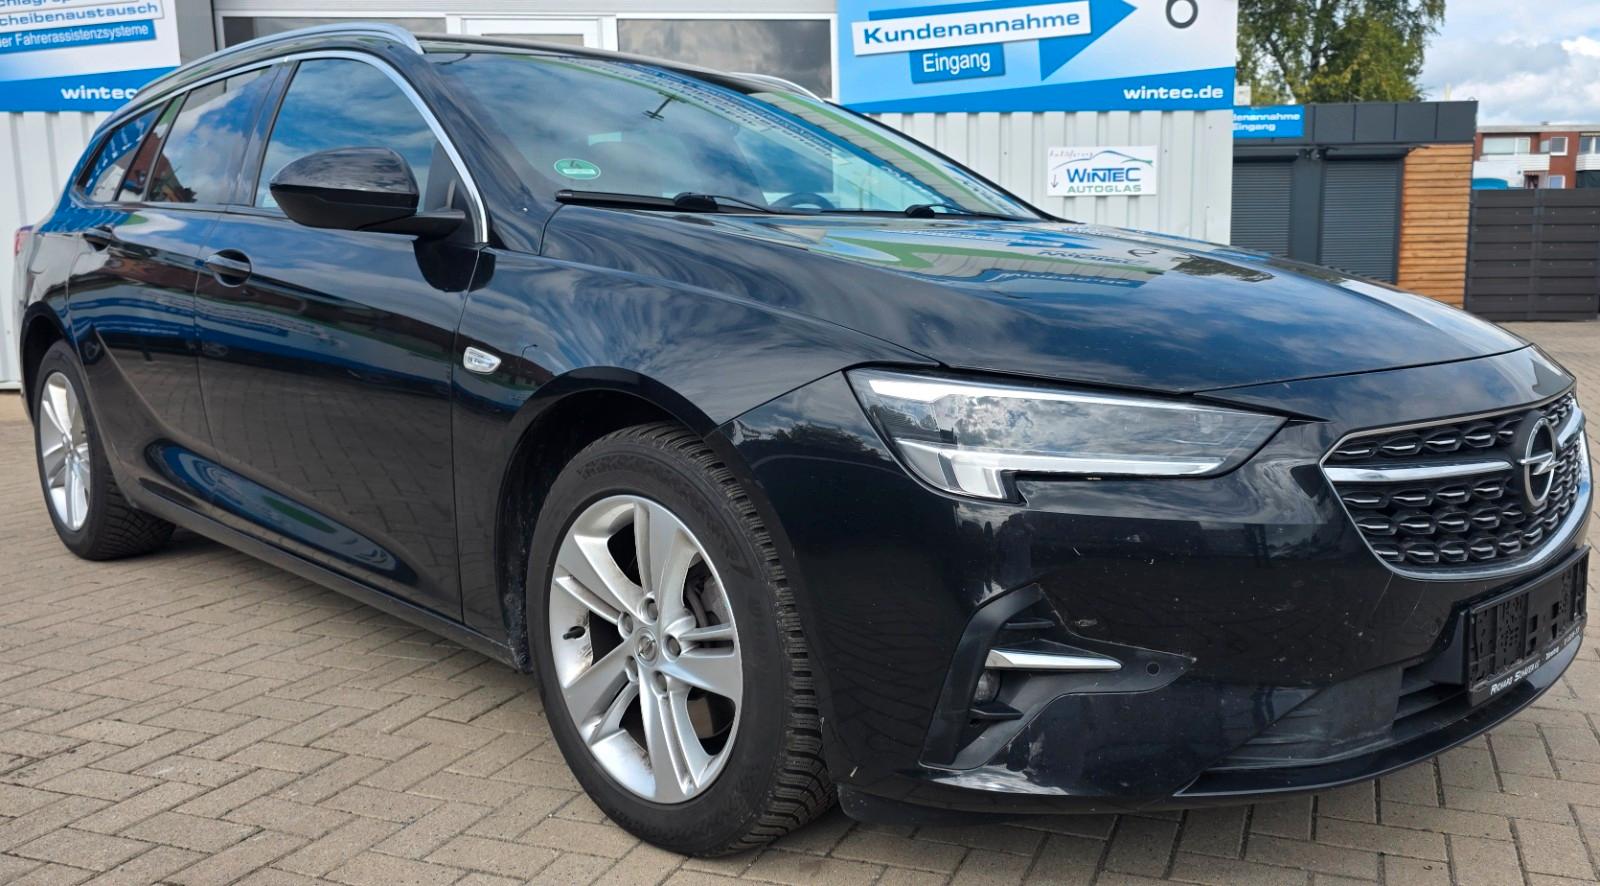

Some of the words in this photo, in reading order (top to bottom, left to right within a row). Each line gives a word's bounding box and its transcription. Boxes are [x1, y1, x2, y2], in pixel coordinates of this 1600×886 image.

[15, 25, 149, 46] Fahrerassistenzsysteme
[864, 13, 1080, 44] Kundenannahme
[922, 52, 991, 75] Eingang
[1123, 85, 1224, 99] wintec.de
[1067, 185, 1142, 193] AUTOGLAS
